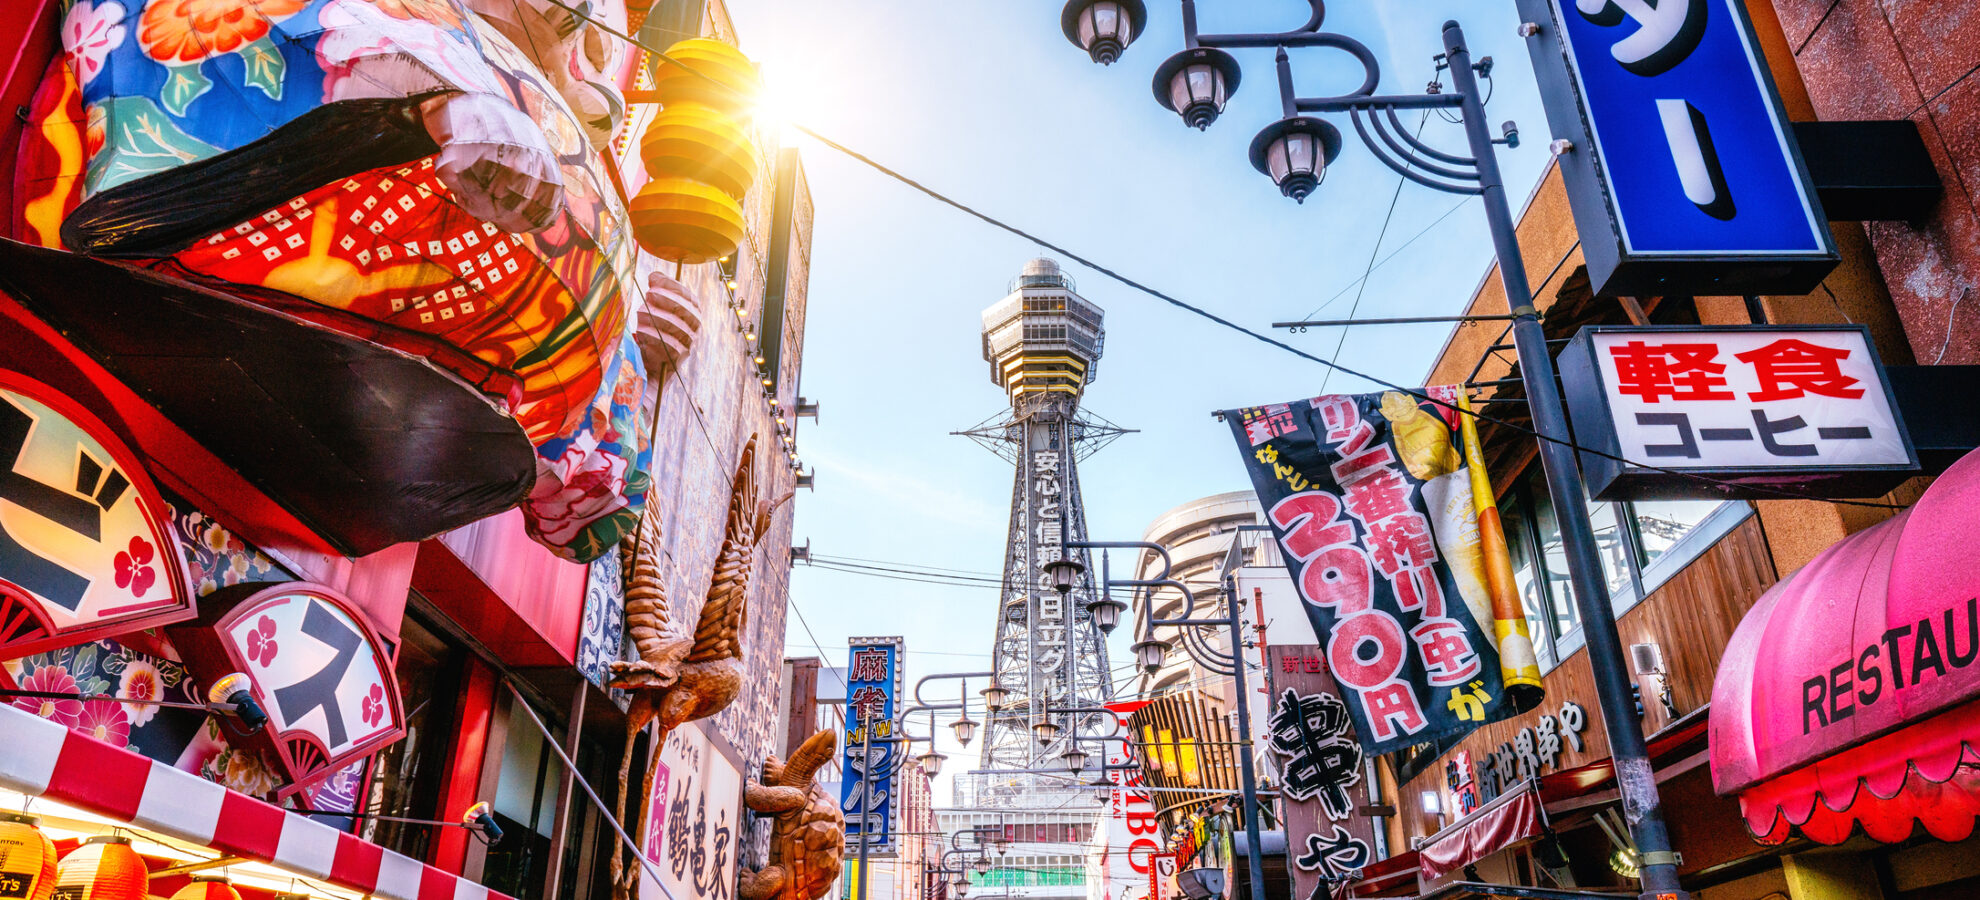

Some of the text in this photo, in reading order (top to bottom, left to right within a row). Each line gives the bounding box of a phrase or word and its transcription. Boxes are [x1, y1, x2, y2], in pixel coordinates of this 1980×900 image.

[1609, 338, 1866, 403] 軽食
[1635, 409, 1873, 458] コーヒー
[274, 597, 361, 750] ス
[1034, 450, 1067, 759] 安心と信頼の日立グル
[1268, 490, 1430, 743] 290円
[1802, 597, 1979, 736] RESTAU
[849, 648, 888, 720] 麻雀
[650, 774, 666, 857] 名代
[1268, 687, 1370, 880] 串や
